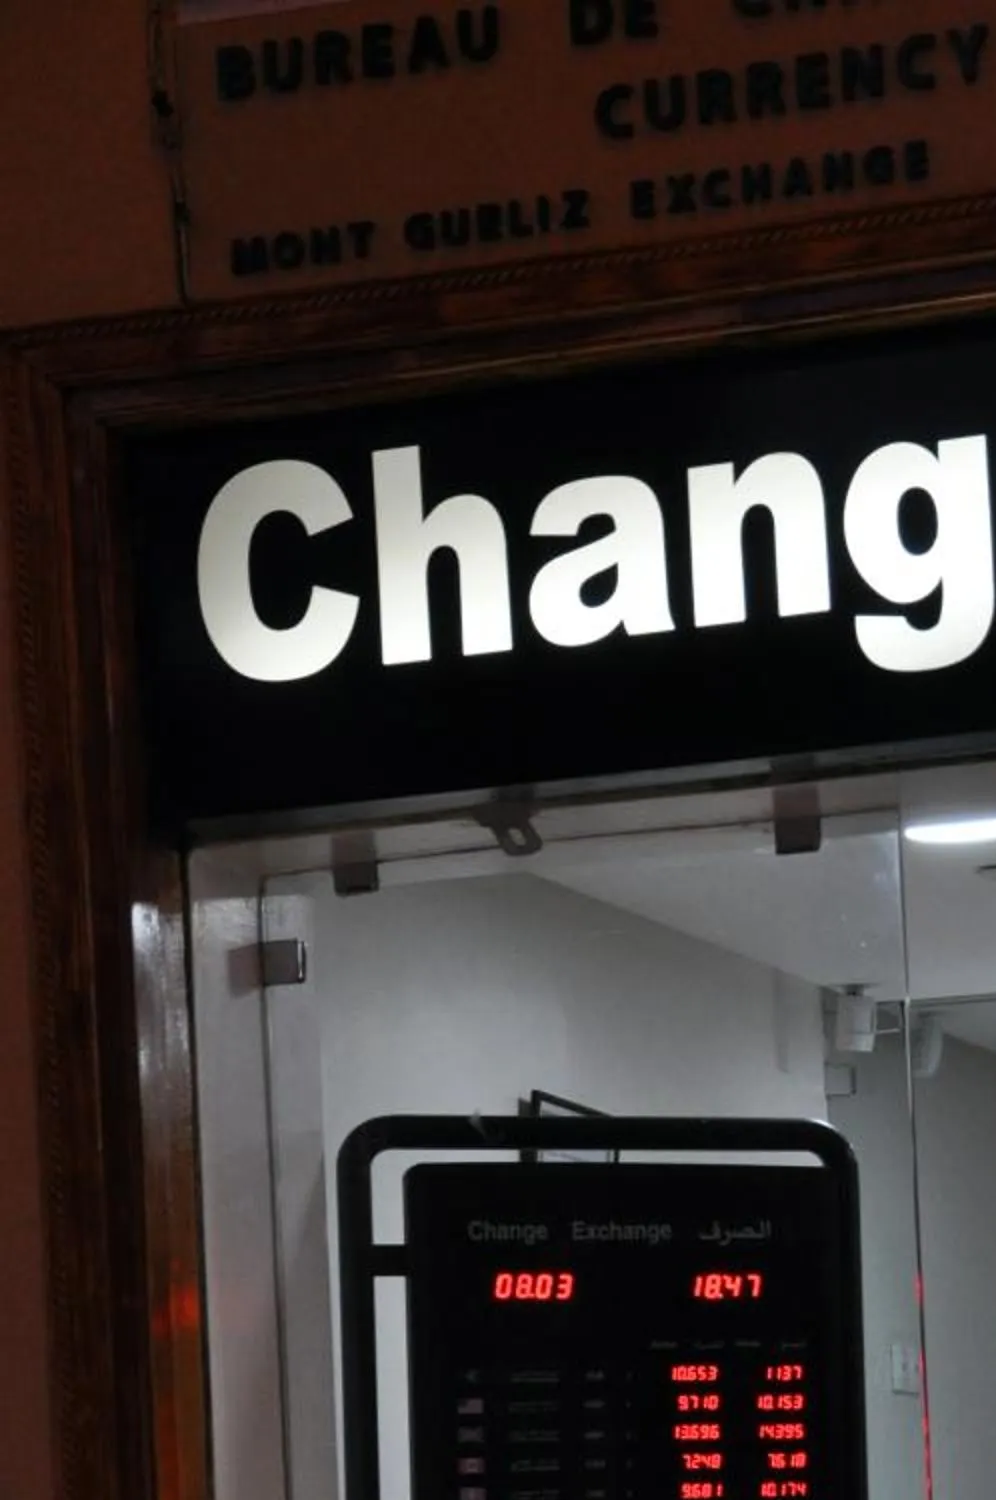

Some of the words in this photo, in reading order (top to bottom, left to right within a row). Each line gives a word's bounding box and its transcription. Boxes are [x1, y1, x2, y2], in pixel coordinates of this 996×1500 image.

[216, 5, 498, 101] BUREAU
[569, 0, 659, 47] DE
[594, 23, 989, 139] CURRENCY
[230, 221, 378, 277] MONT
[629, 140, 931, 220] EXCHANGE
[467, 1220, 549, 1246] Change
[571, 1219, 672, 1242] Exchange
